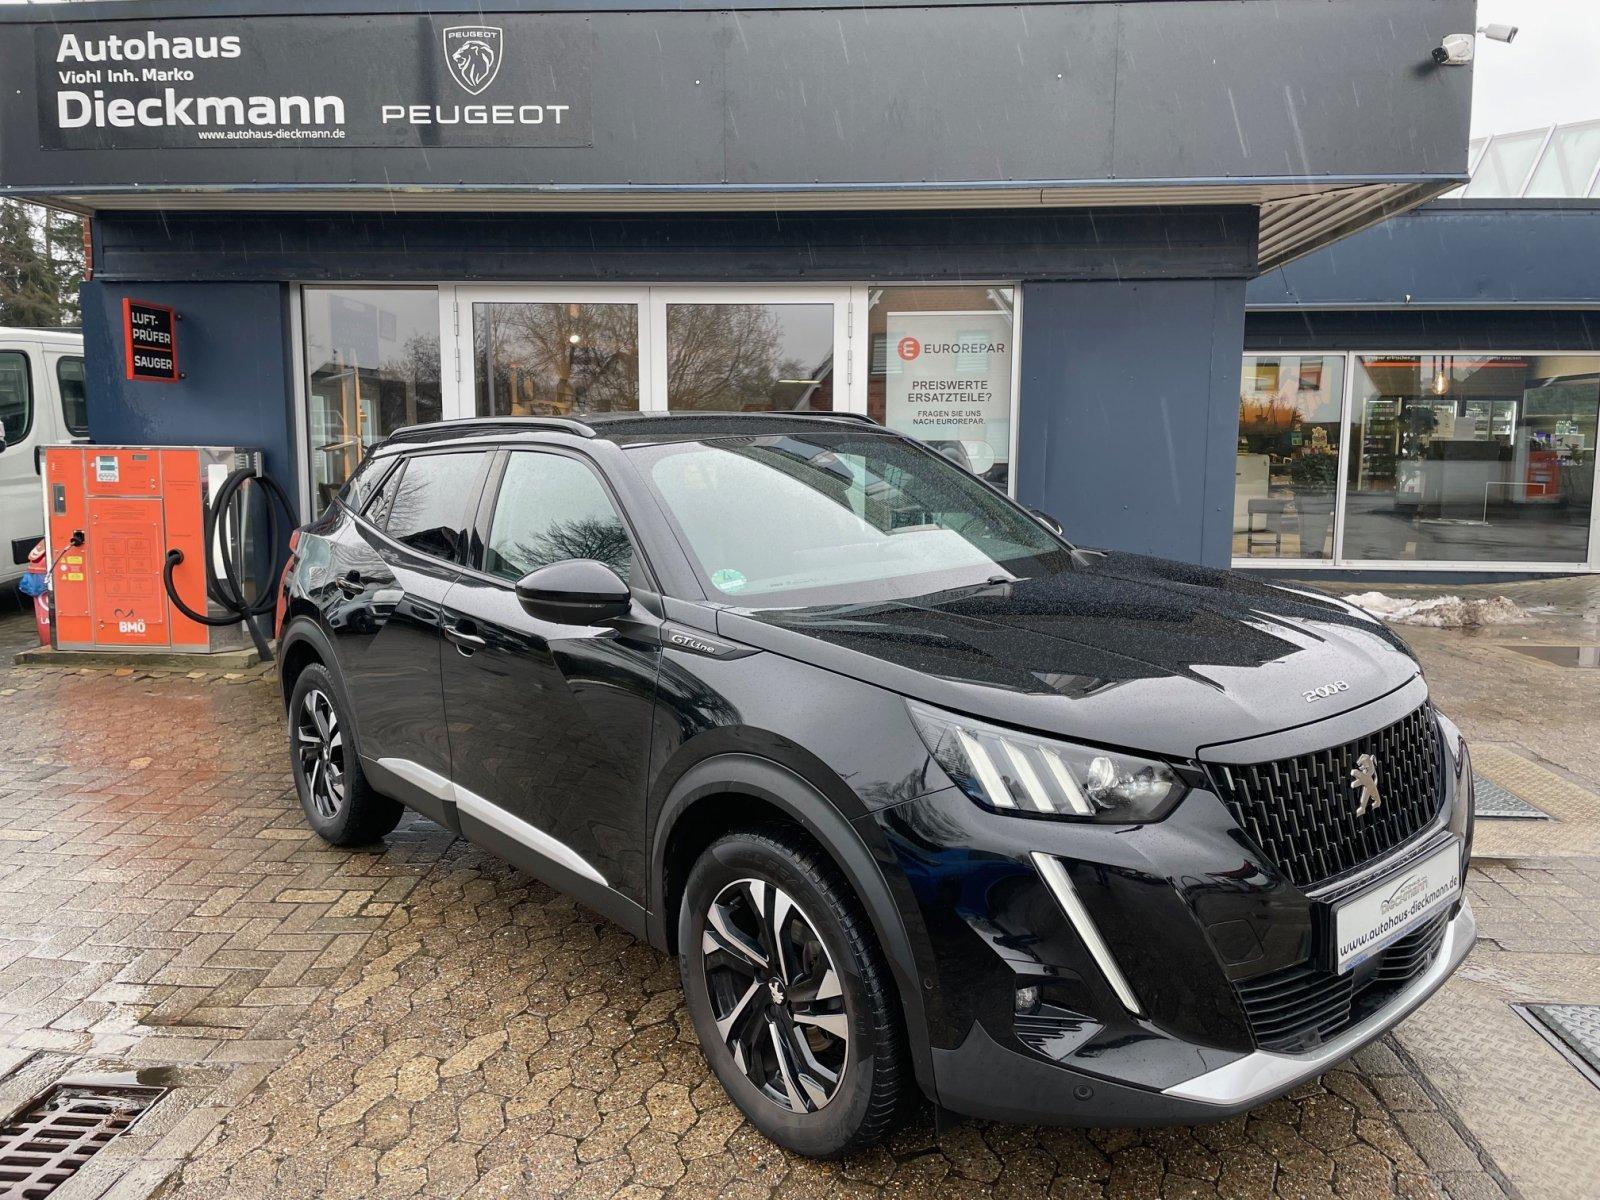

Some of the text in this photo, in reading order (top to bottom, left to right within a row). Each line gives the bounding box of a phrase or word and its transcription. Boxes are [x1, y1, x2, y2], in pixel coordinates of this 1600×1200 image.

[56, 30, 242, 62] Autohaus
[58, 67, 195, 84] Viohl Inh. Marko
[57, 87, 346, 129] Dieckmann
[382, 105, 569, 124] PEUGEOT
[198, 128, 346, 140] www.autohaus-dieckmann.de
[131, 311, 159, 326] LUFT-
[132, 327, 171, 344] PRÜFER
[924, 343, 1005, 354] EUROREPAR
[134, 355, 173, 370] SAUGER
[912, 380, 988, 390] PREISWERTE
[907, 392, 992, 403] ERSATZTEILE?
[119, 619, 146, 633] BMÖ
[671, 634, 692, 646] GT
[1302, 680, 1350, 703] 2008
[1340, 875, 1458, 957] www.autohaus-dieckmann.de
